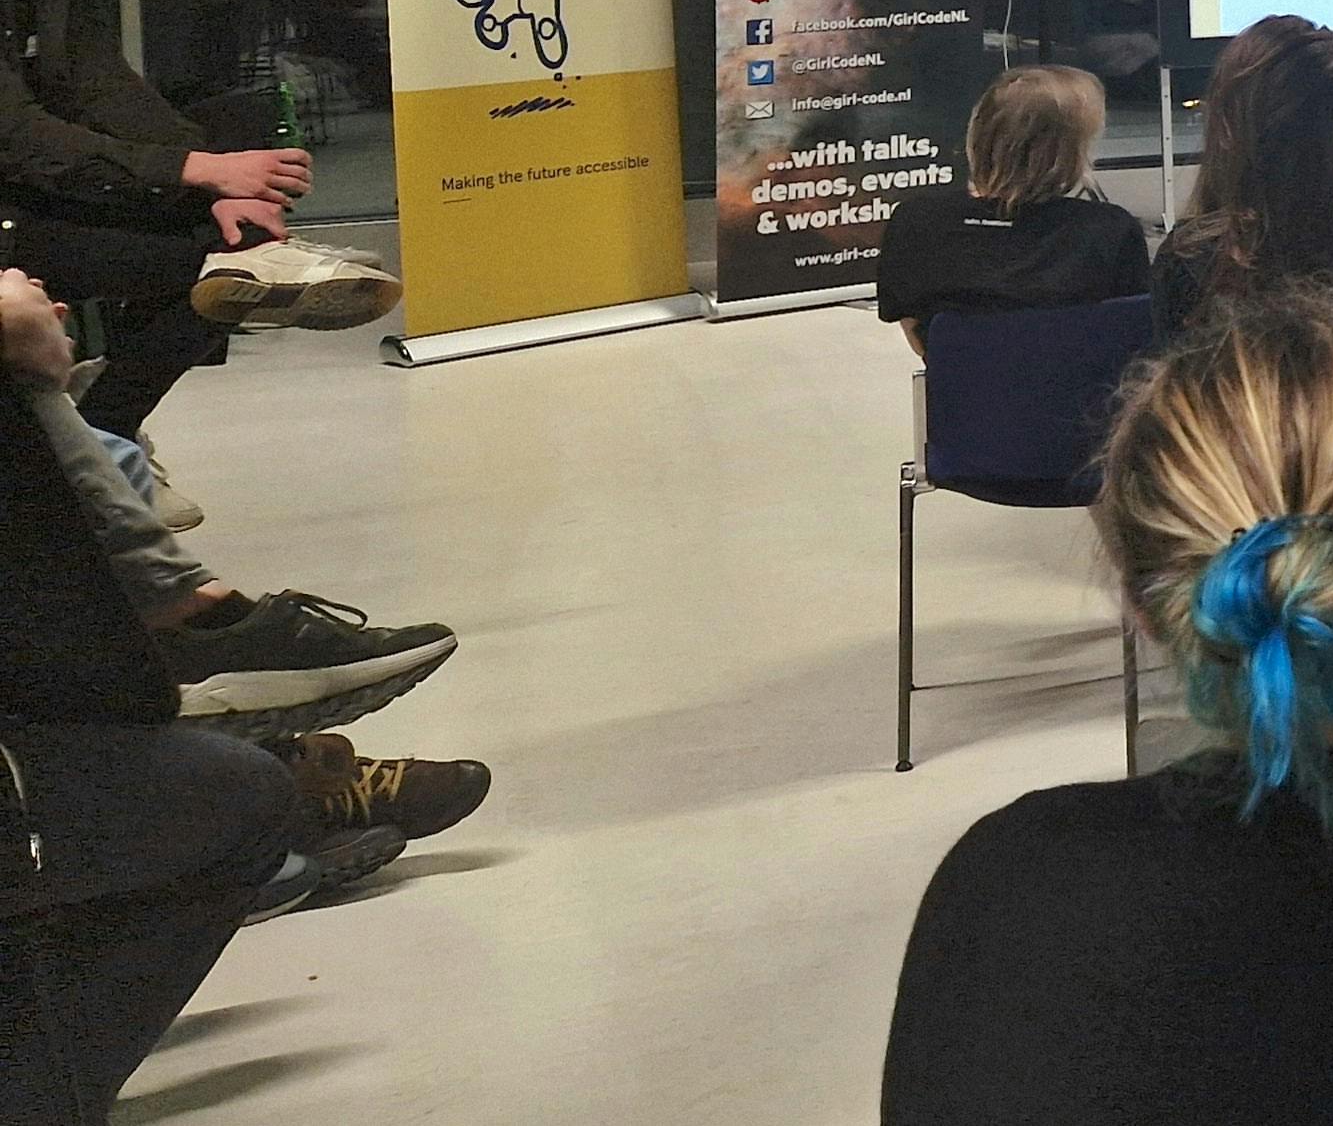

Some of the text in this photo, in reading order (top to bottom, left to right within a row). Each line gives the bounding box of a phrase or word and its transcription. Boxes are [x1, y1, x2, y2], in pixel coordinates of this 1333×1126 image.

[791, 10, 970, 34] facebook.com/GirlCodeNL
[792, 53, 885, 74] @GirlCodeNL
[767, 134, 939, 172] ...with talks,
[442, 155, 650, 192] Making the future accessible
[752, 164, 953, 204] demos, events
[757, 197, 900, 235] & worksh
[794, 247, 881, 269] www.girl-co
